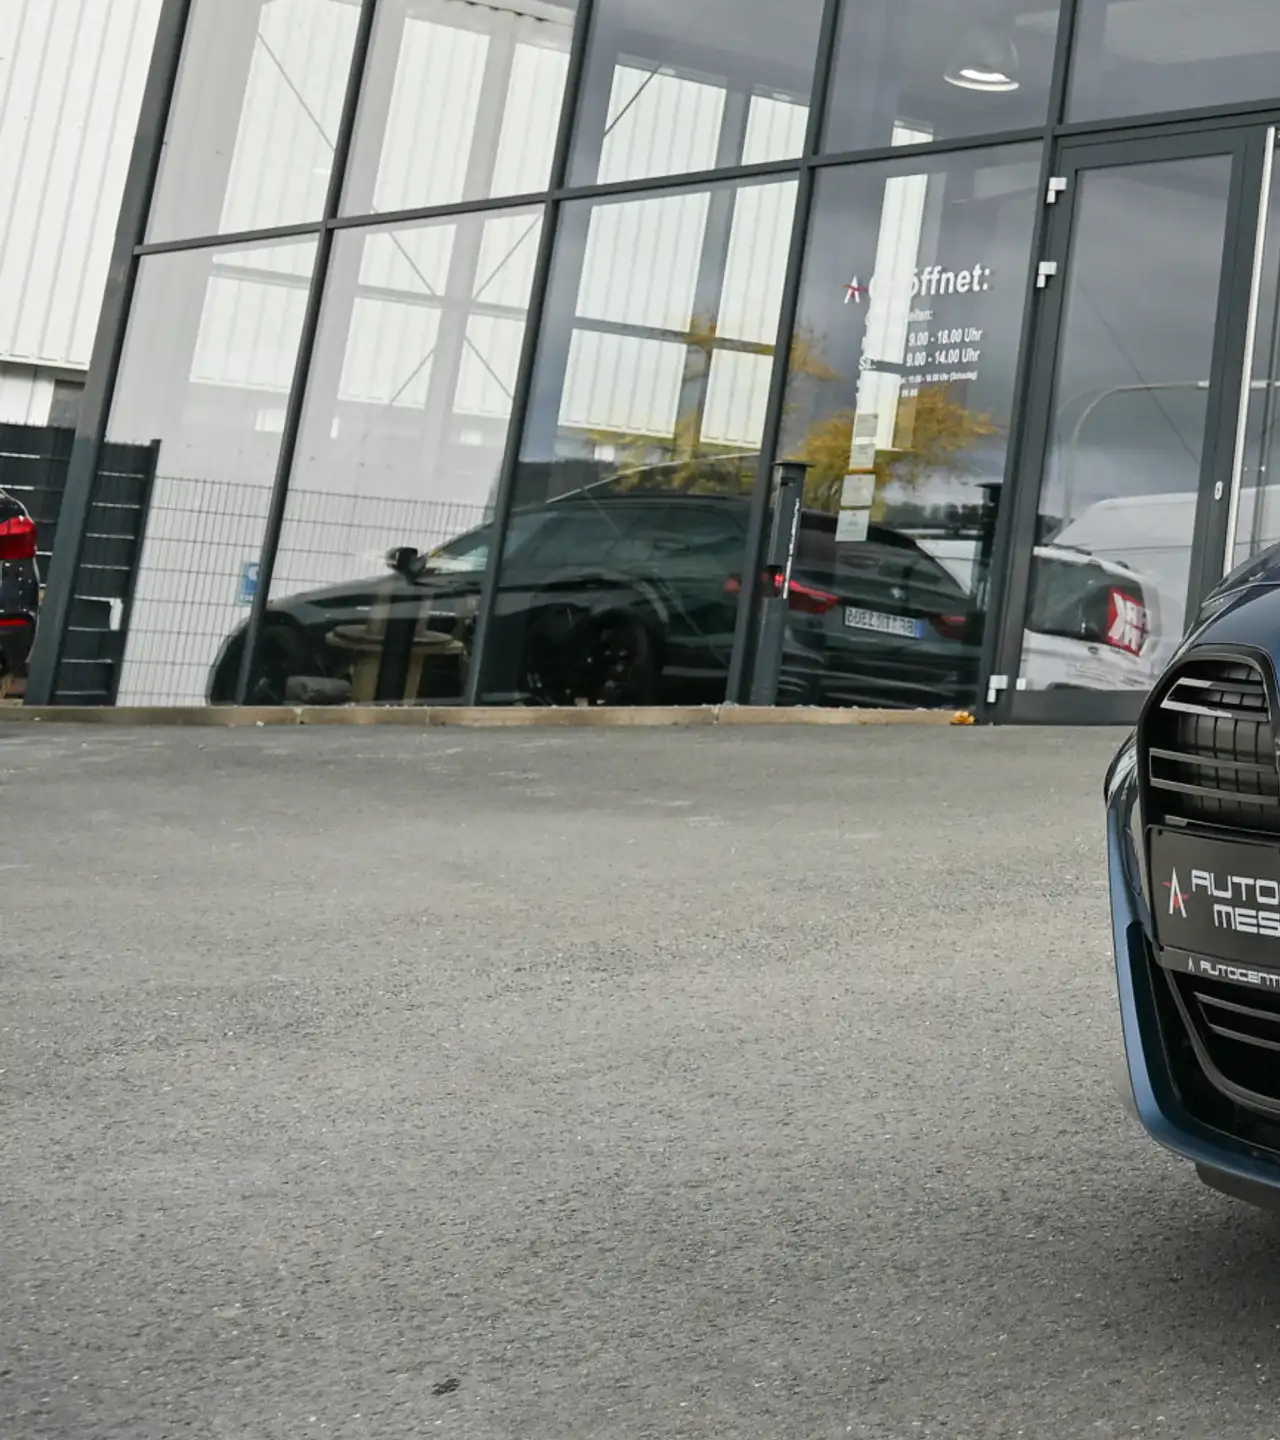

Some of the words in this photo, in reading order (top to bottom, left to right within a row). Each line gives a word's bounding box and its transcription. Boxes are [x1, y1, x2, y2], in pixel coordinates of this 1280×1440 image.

[869, 263, 990, 298] öffnet:
[908, 331, 929, 347] 9.00
[964, 327, 983, 342] Uhr
[906, 351, 927, 367] 9.00
[961, 347, 981, 362] Uhr
